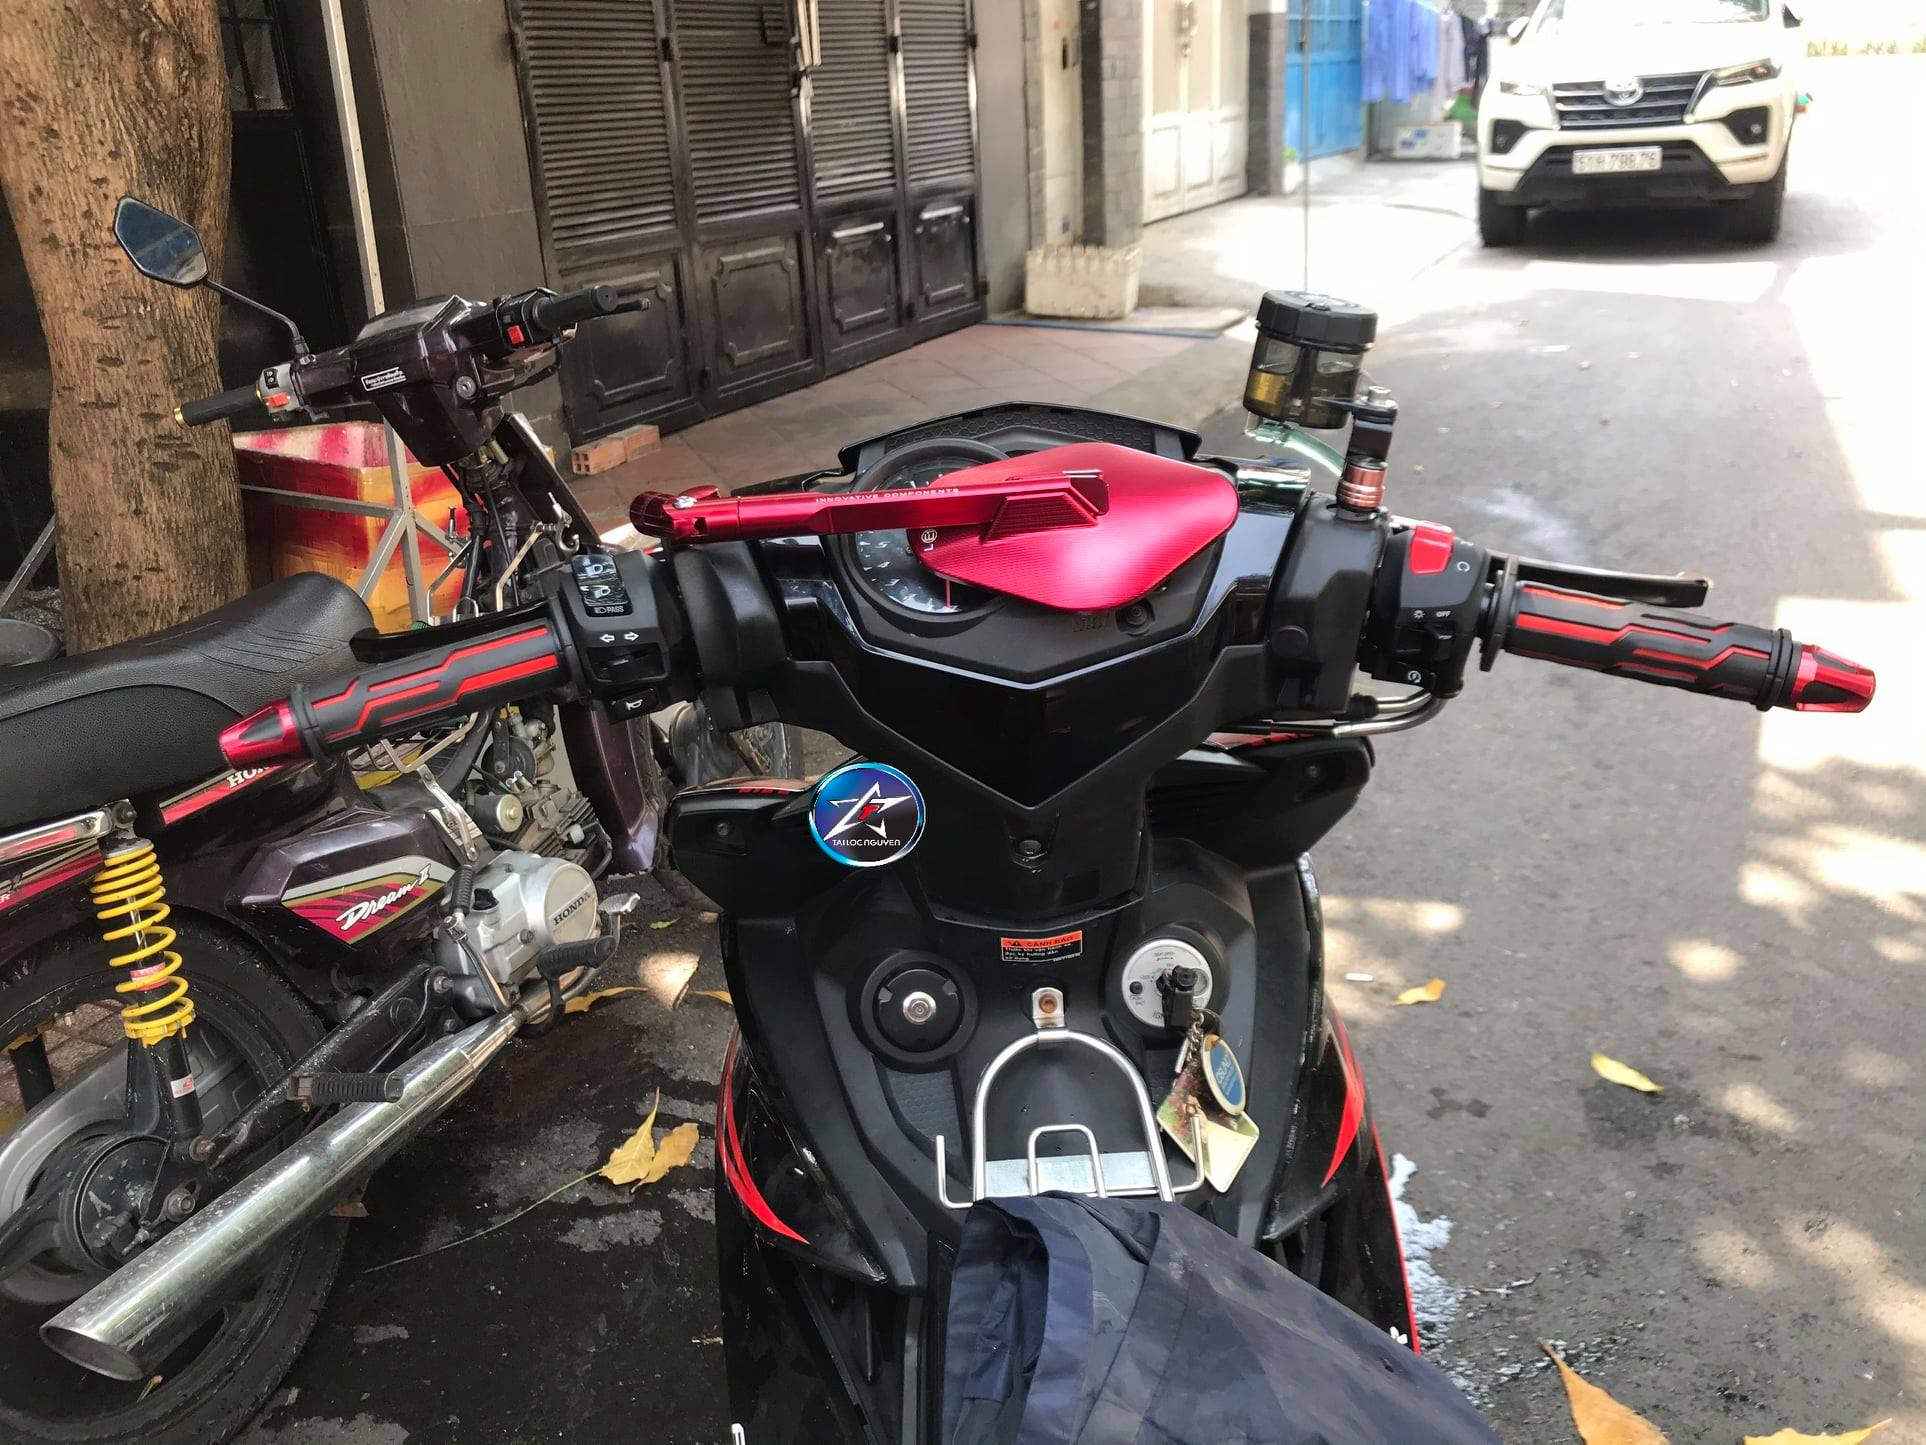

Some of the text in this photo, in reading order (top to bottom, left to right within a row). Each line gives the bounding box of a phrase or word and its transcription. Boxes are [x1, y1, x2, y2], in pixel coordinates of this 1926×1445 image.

[815, 488, 960, 503] INNOVATIVE COMPONENTS
[336, 880, 419, 931] Dream
[553, 891, 590, 926] HONDA
